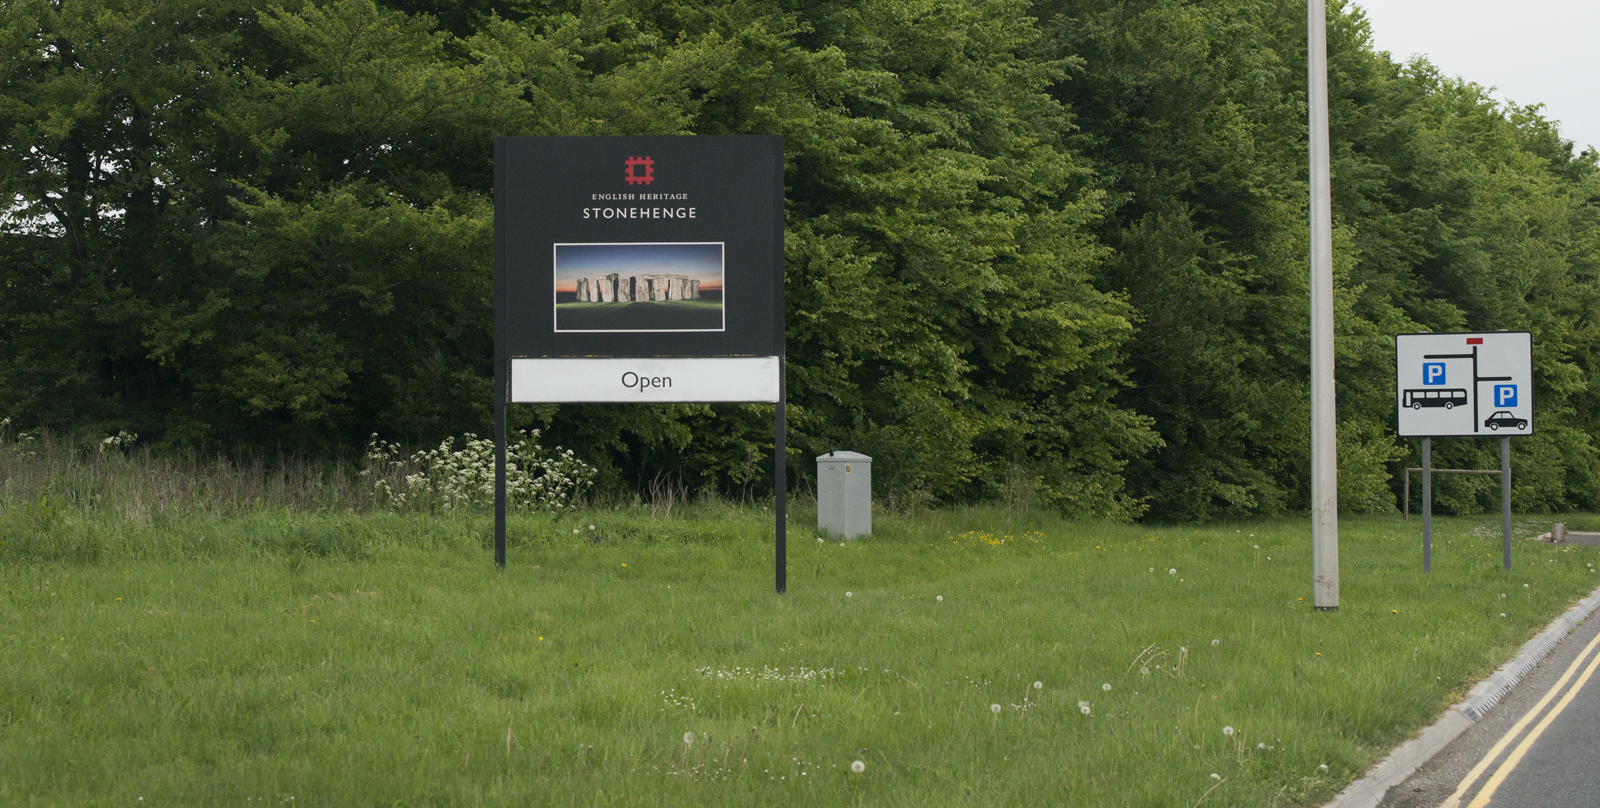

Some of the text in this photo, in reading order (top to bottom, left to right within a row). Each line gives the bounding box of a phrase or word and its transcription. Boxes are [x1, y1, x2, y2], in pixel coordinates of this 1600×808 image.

[591, 193, 635, 201] ENGLISH
[582, 207, 697, 219] STONEHENGE
[621, 371, 672, 392] Open
[1428, 365, 1442, 383] P
[1499, 387, 1514, 405] P
